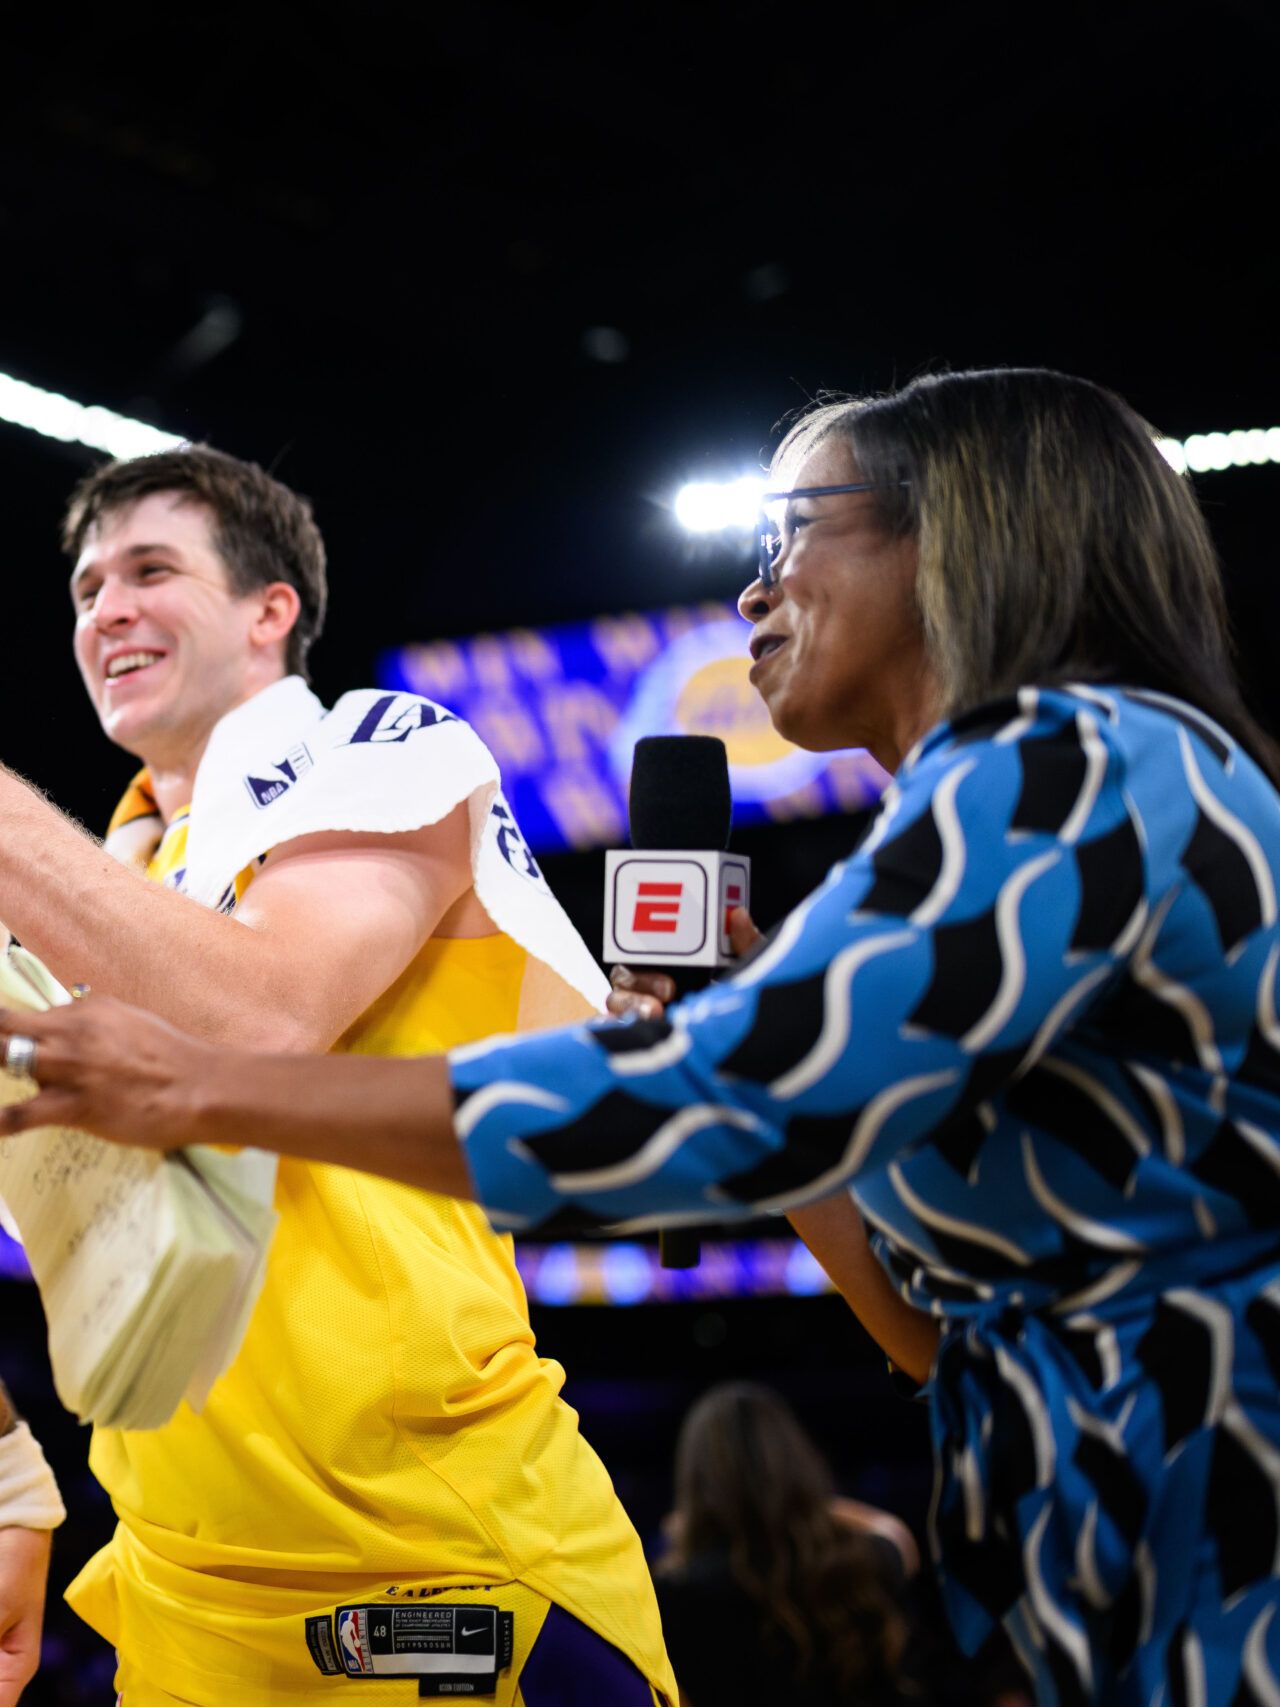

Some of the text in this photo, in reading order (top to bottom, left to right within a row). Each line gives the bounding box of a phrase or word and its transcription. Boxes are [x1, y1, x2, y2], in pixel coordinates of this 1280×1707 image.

[260, 782, 285, 804] NBA
[632, 882, 683, 933] E
[395, 1611, 452, 1619] ENGINEERED
[373, 1625, 387, 1637] 48
